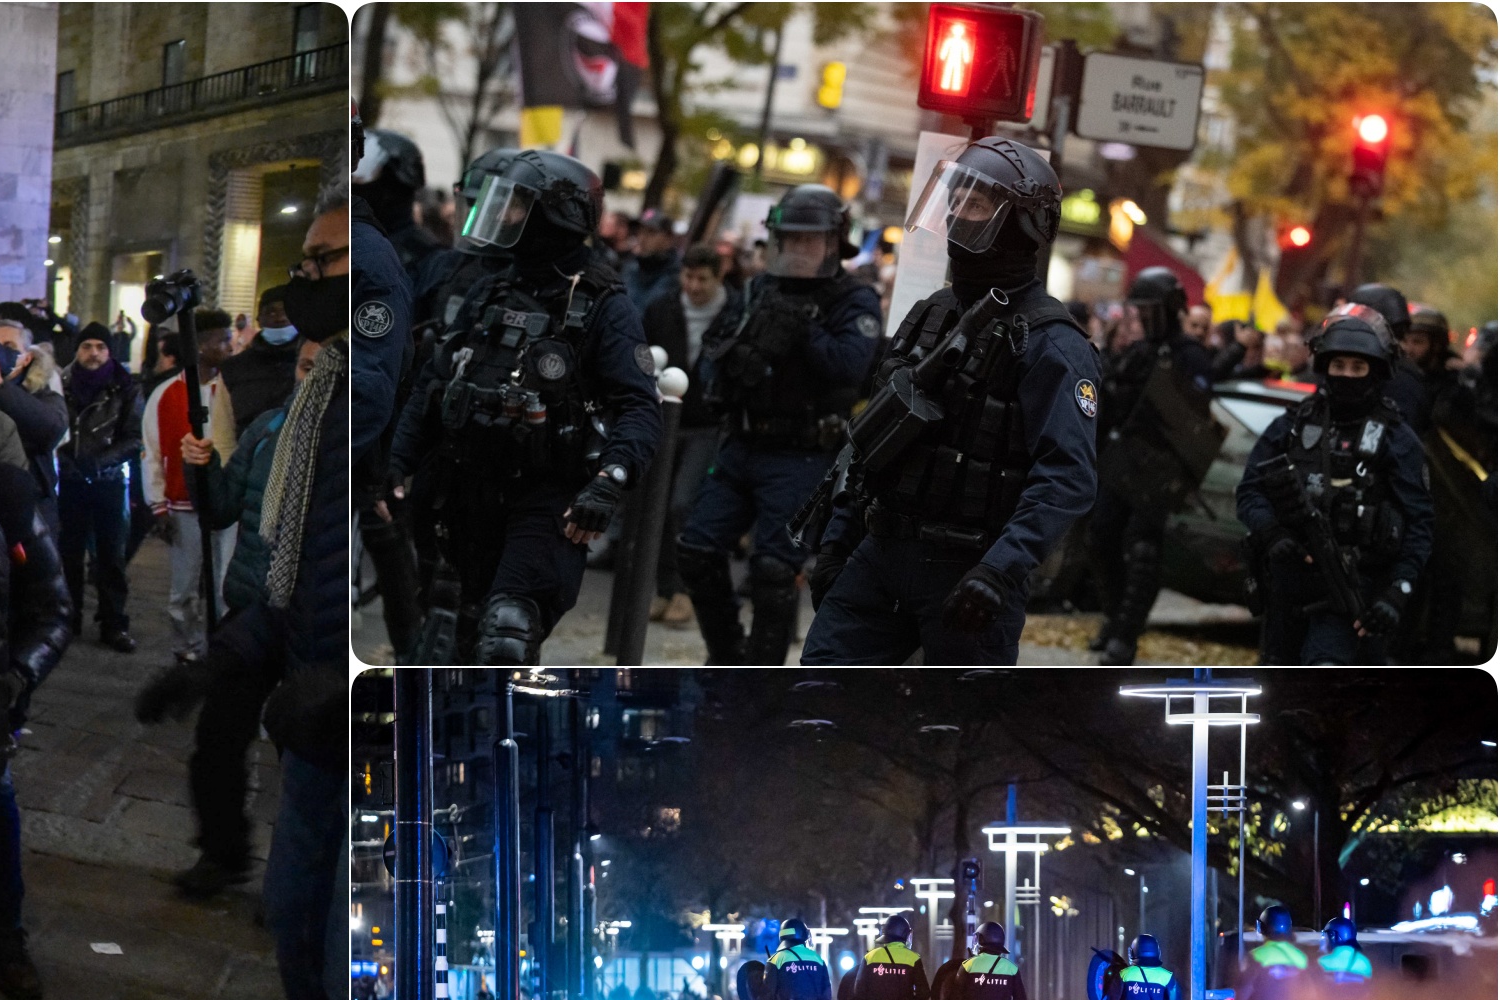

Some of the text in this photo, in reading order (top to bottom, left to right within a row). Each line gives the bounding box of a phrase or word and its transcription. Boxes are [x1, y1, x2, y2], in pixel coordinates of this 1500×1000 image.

[1131, 74, 1161, 92] Rue
[1112, 91, 1176, 118] BARRAULT
[873, 964, 906, 976] POLITIE
[974, 974, 1008, 986] POLITIE
